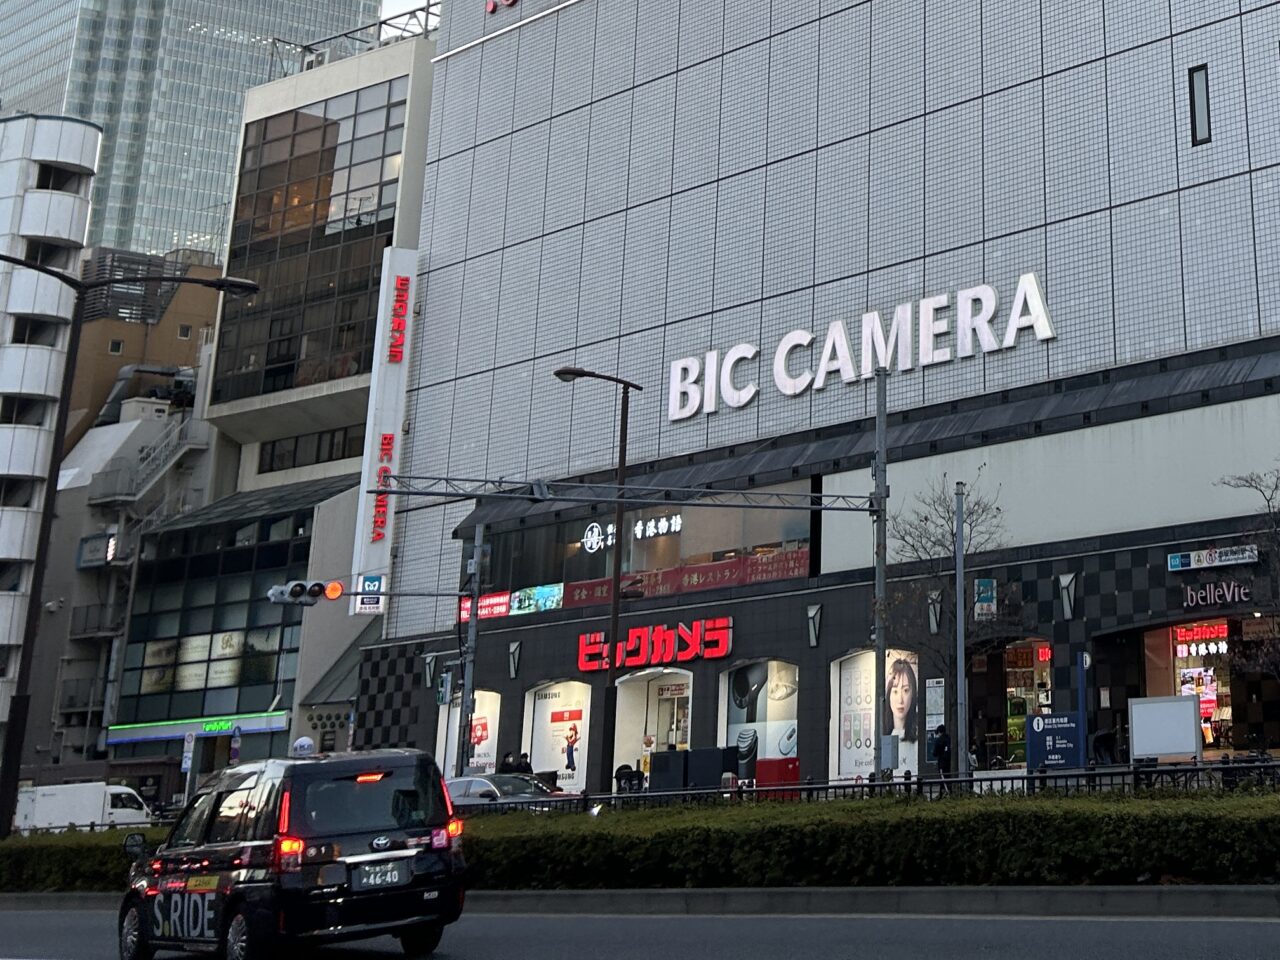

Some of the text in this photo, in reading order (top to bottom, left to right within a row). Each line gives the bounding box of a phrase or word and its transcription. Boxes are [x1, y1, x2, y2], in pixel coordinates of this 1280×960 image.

[668, 271, 1058, 422] BIC CAMERA
[379, 433, 394, 463] BIC
[202, 720, 233, 731] FamilyMart
[153, 892, 216, 937] S.RIDE
